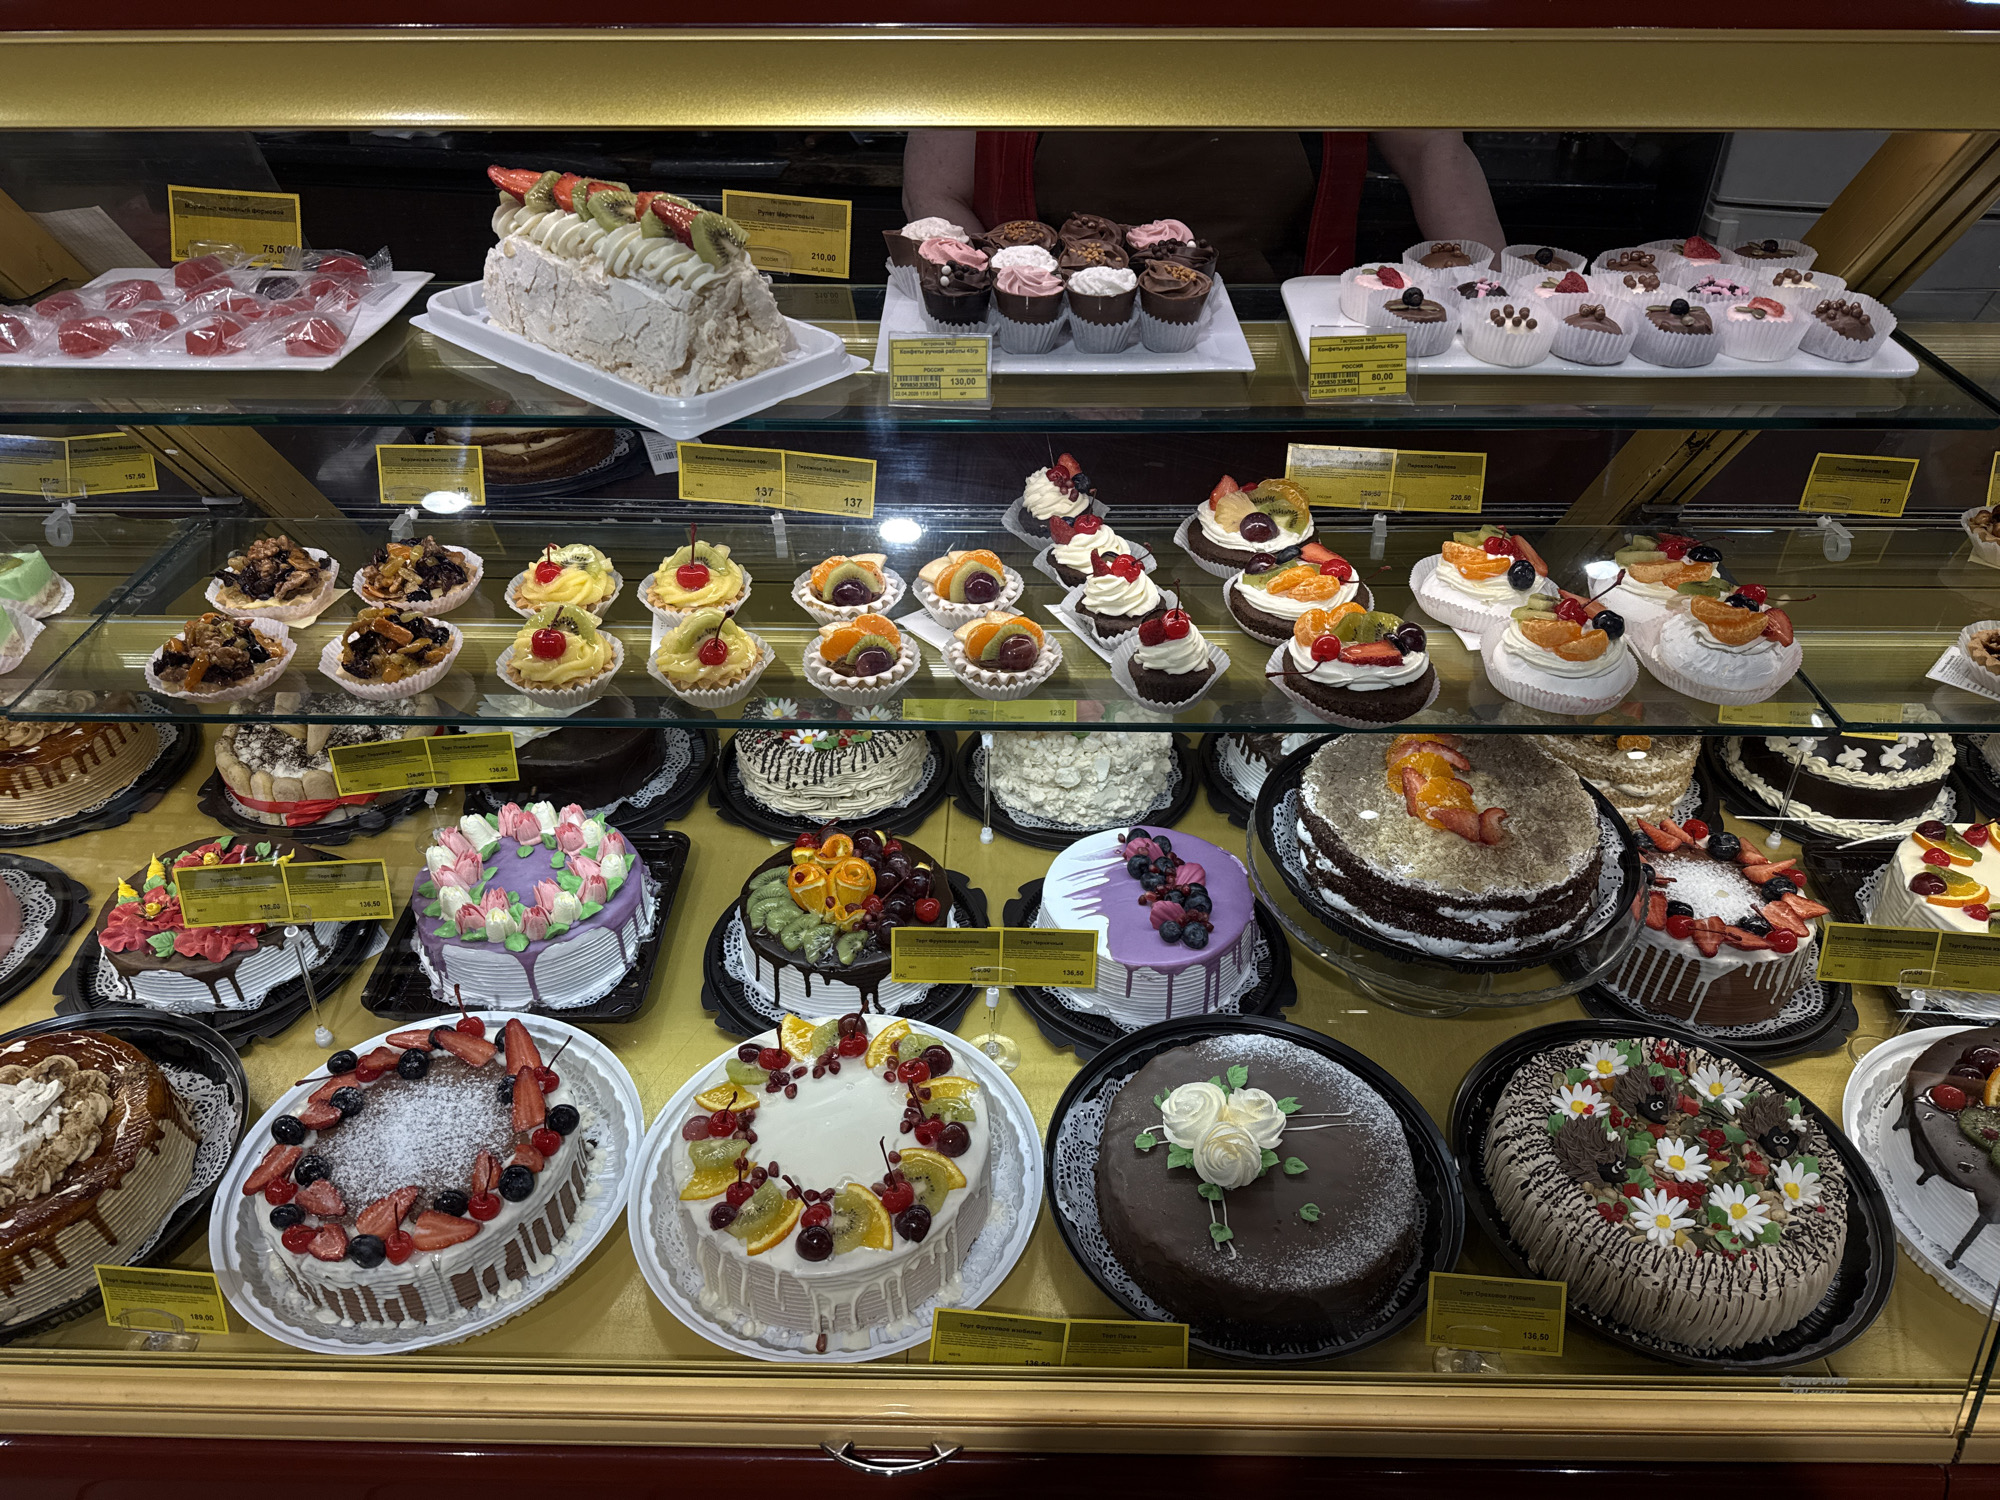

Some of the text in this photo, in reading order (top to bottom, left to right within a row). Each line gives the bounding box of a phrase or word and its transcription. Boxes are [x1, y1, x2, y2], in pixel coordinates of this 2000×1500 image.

[811, 252, 836, 262] 210,00
[1372, 373, 1393, 381] 80,00
[950, 378, 976, 386] 130,00
[755, 486, 774, 497] 137
[844, 497, 863, 508] 137
[1475, 1290, 1507, 1299] Ореховое
[190, 1313, 214, 1322] 189,00
[975, 1324, 1010, 1333] Фруктовое
[1011, 1327, 1042, 1336] изобилие
[1523, 1332, 1549, 1341] 136,50
